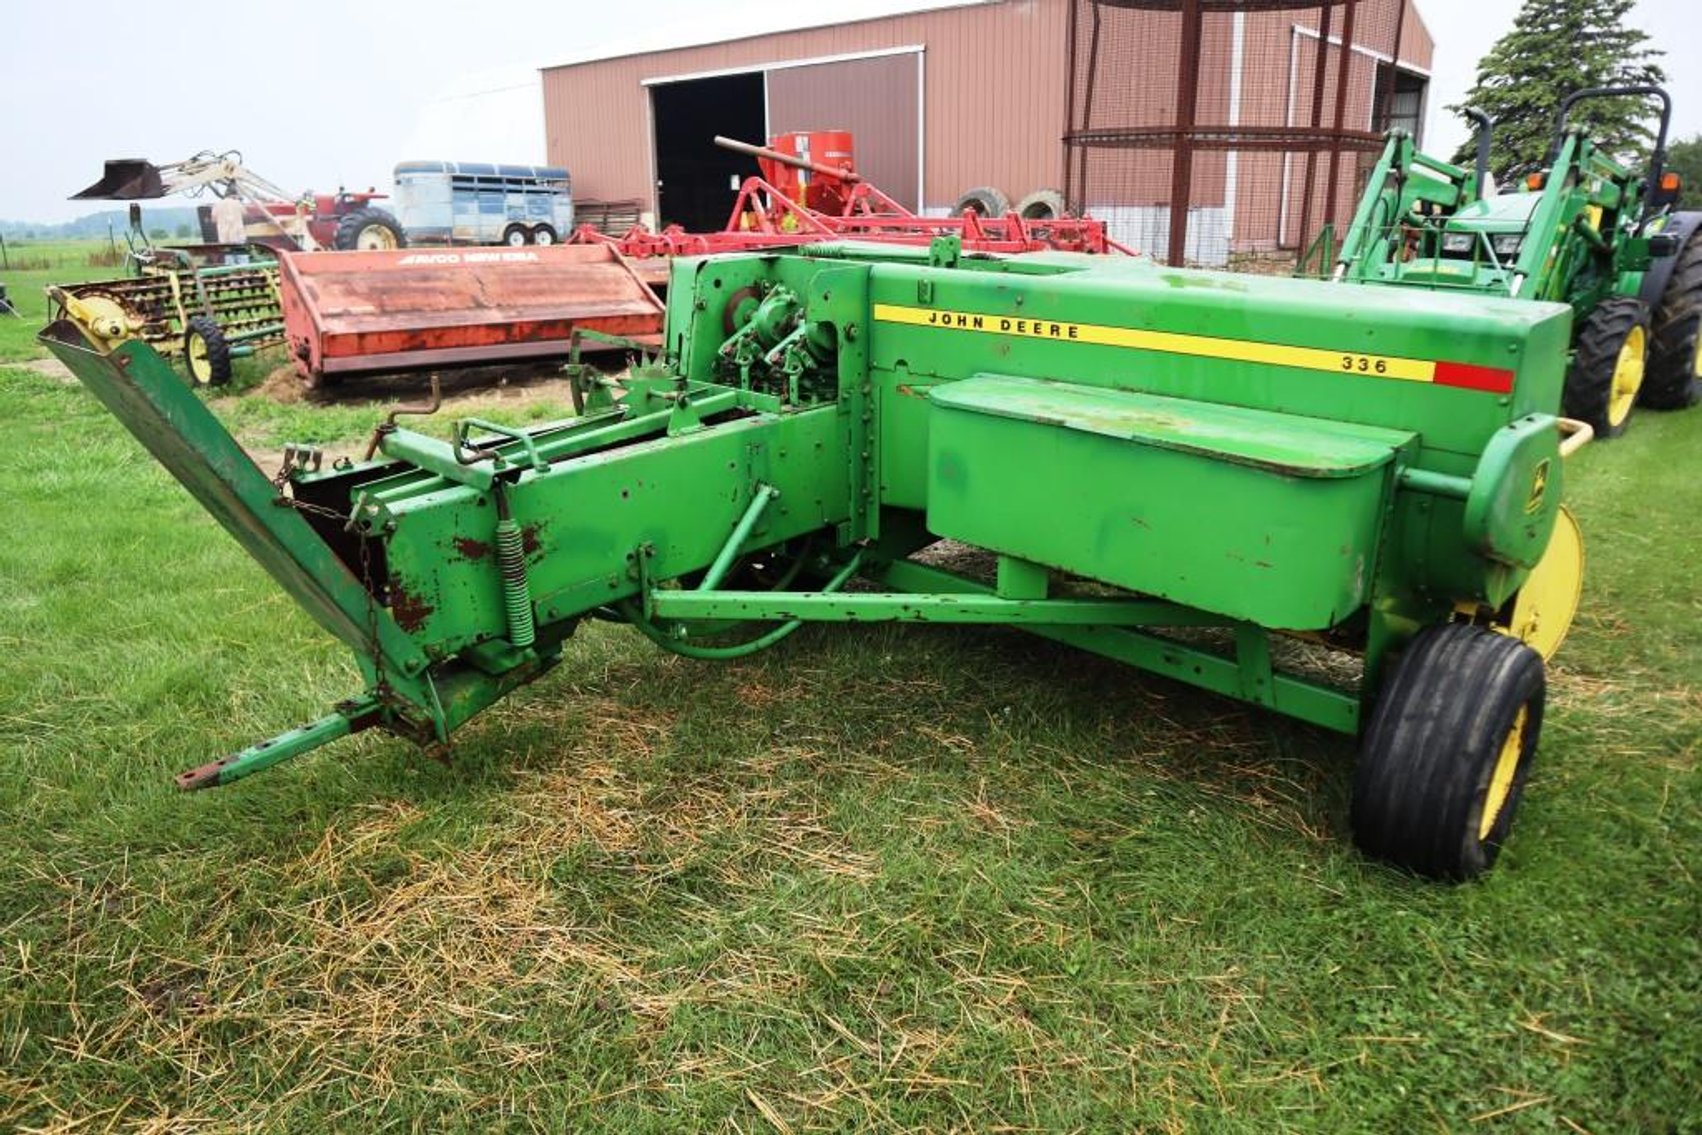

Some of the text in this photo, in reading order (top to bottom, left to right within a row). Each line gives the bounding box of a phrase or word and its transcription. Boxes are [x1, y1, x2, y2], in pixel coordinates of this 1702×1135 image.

[929, 312, 1078, 338] JOHN DEERE
[1342, 356, 1386, 373] 336
